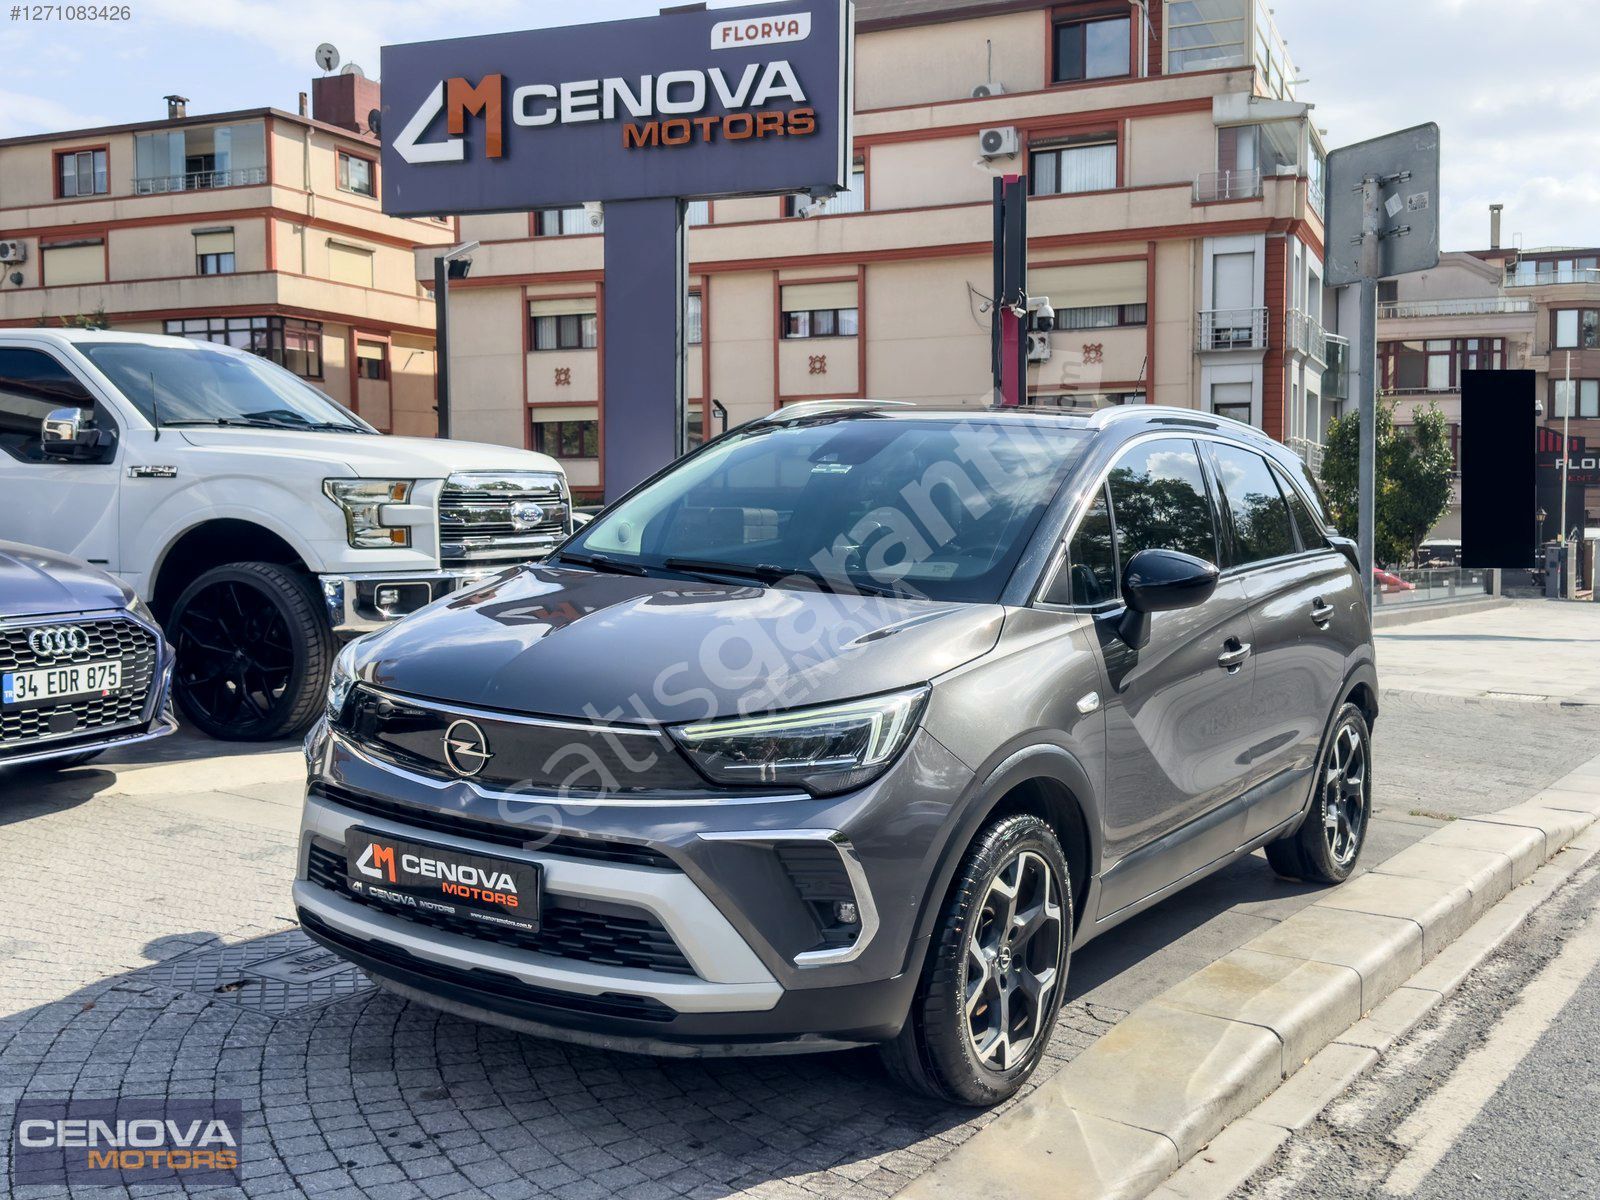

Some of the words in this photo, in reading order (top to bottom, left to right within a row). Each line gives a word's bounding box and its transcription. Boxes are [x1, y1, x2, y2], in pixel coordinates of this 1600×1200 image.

[721, 19, 800, 43] FLORYA
[512, 60, 807, 127] CENOVA
[623, 108, 816, 149] MOTORS
[1555, 458, 1600, 470] FLO
[4, 690, 14, 698] TR
[16, 675, 38, 699] 34
[47, 669, 79, 694] EDR
[86, 664, 117, 690] 875
[401, 854, 518, 894] CENOVA
[368, 886, 417, 908] CENOVA
[419, 900, 456, 914] MOTORS
[441, 882, 519, 907] MOTORS
